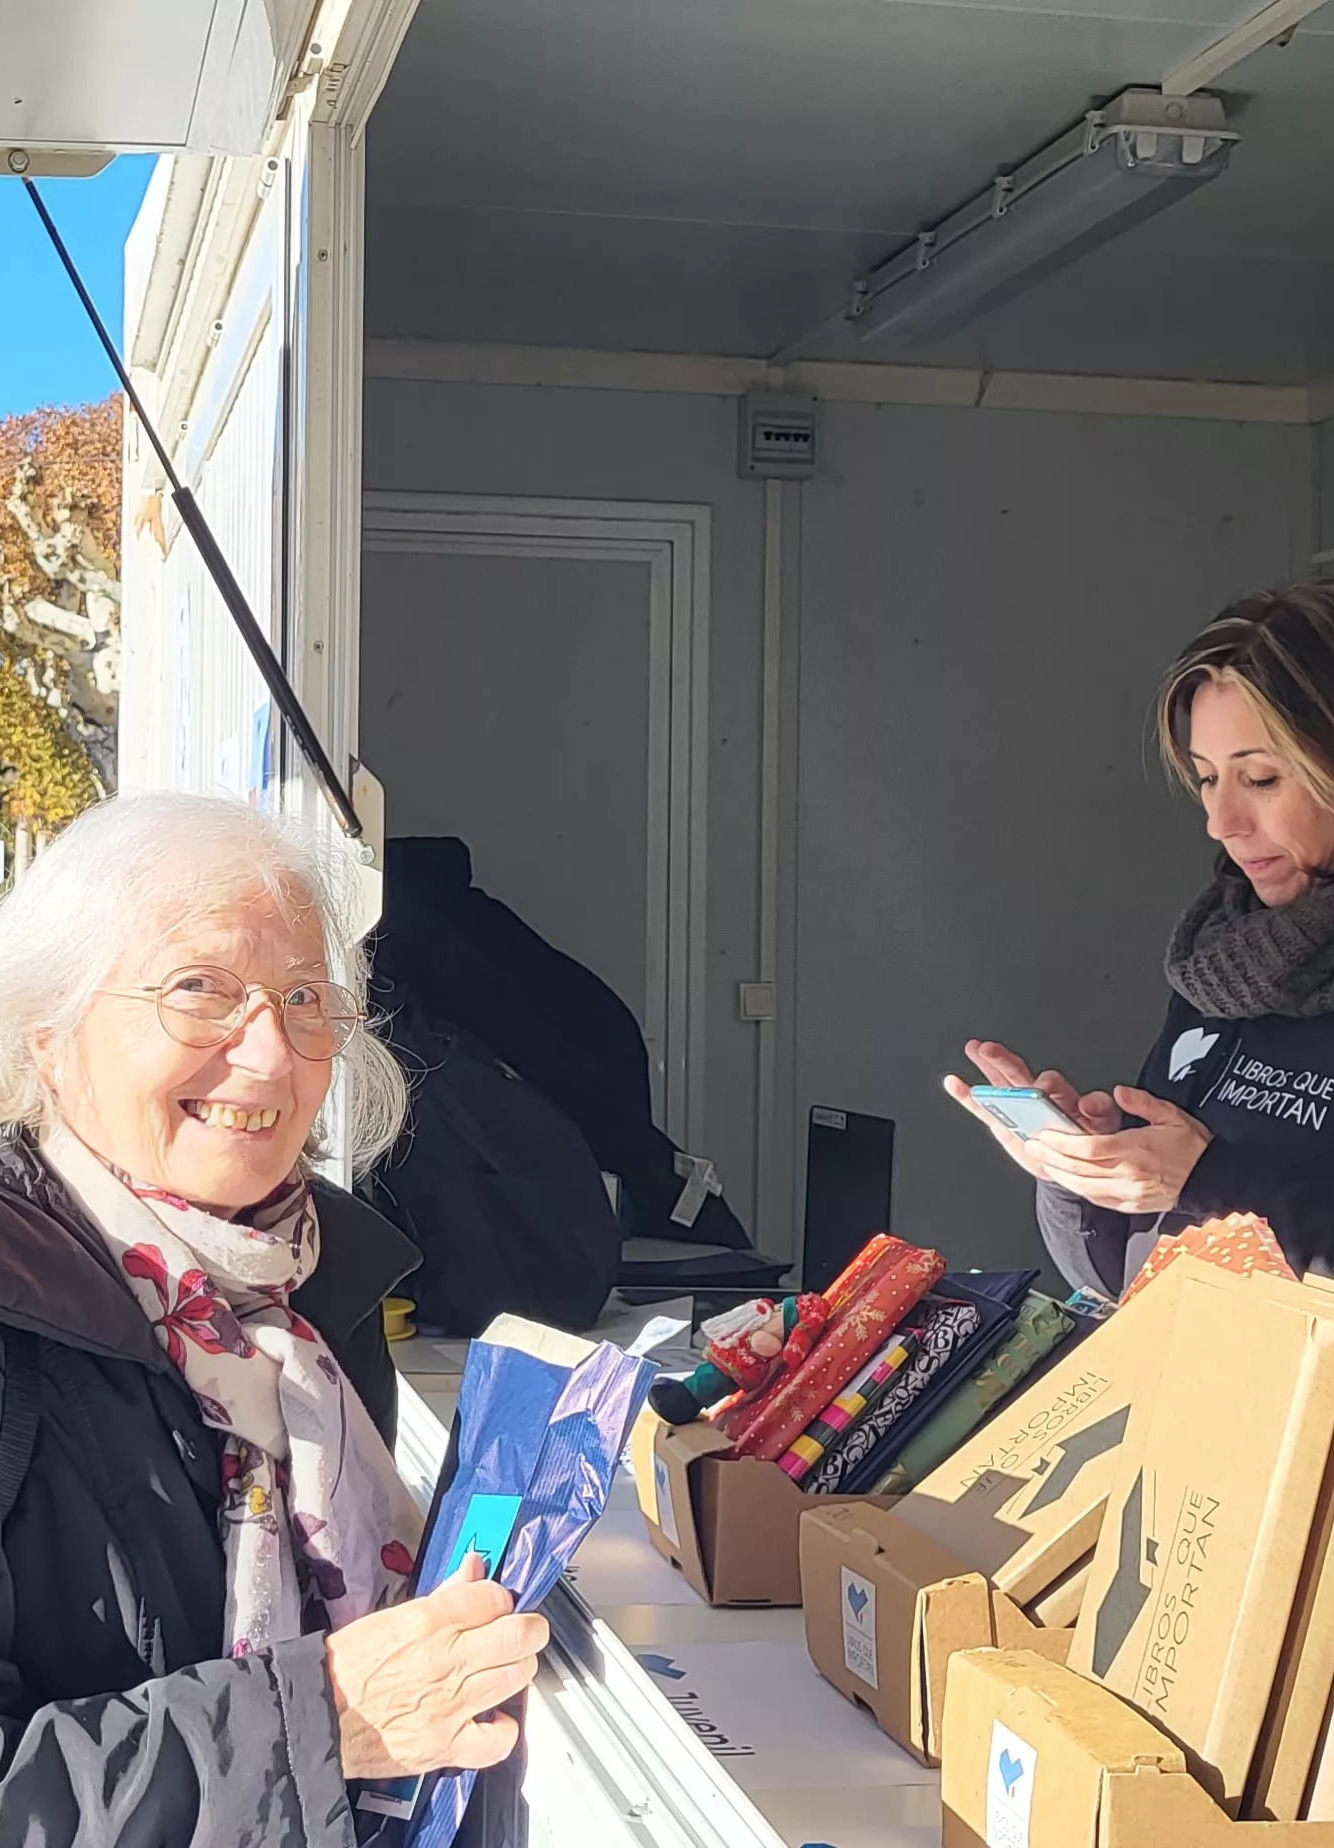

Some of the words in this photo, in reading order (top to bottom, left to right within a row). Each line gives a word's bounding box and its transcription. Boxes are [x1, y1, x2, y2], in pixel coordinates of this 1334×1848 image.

[1217, 1078, 1328, 1131] IMPORTAN
[1233, 1055, 1293, 1088] LIBROS
[960, 1371, 1097, 1488] IMPORTAN
[1033, 1376, 1109, 1441] LIBROS
[1177, 1490, 1203, 1565] QUE
[1155, 1496, 1220, 1712] MPORTAN
